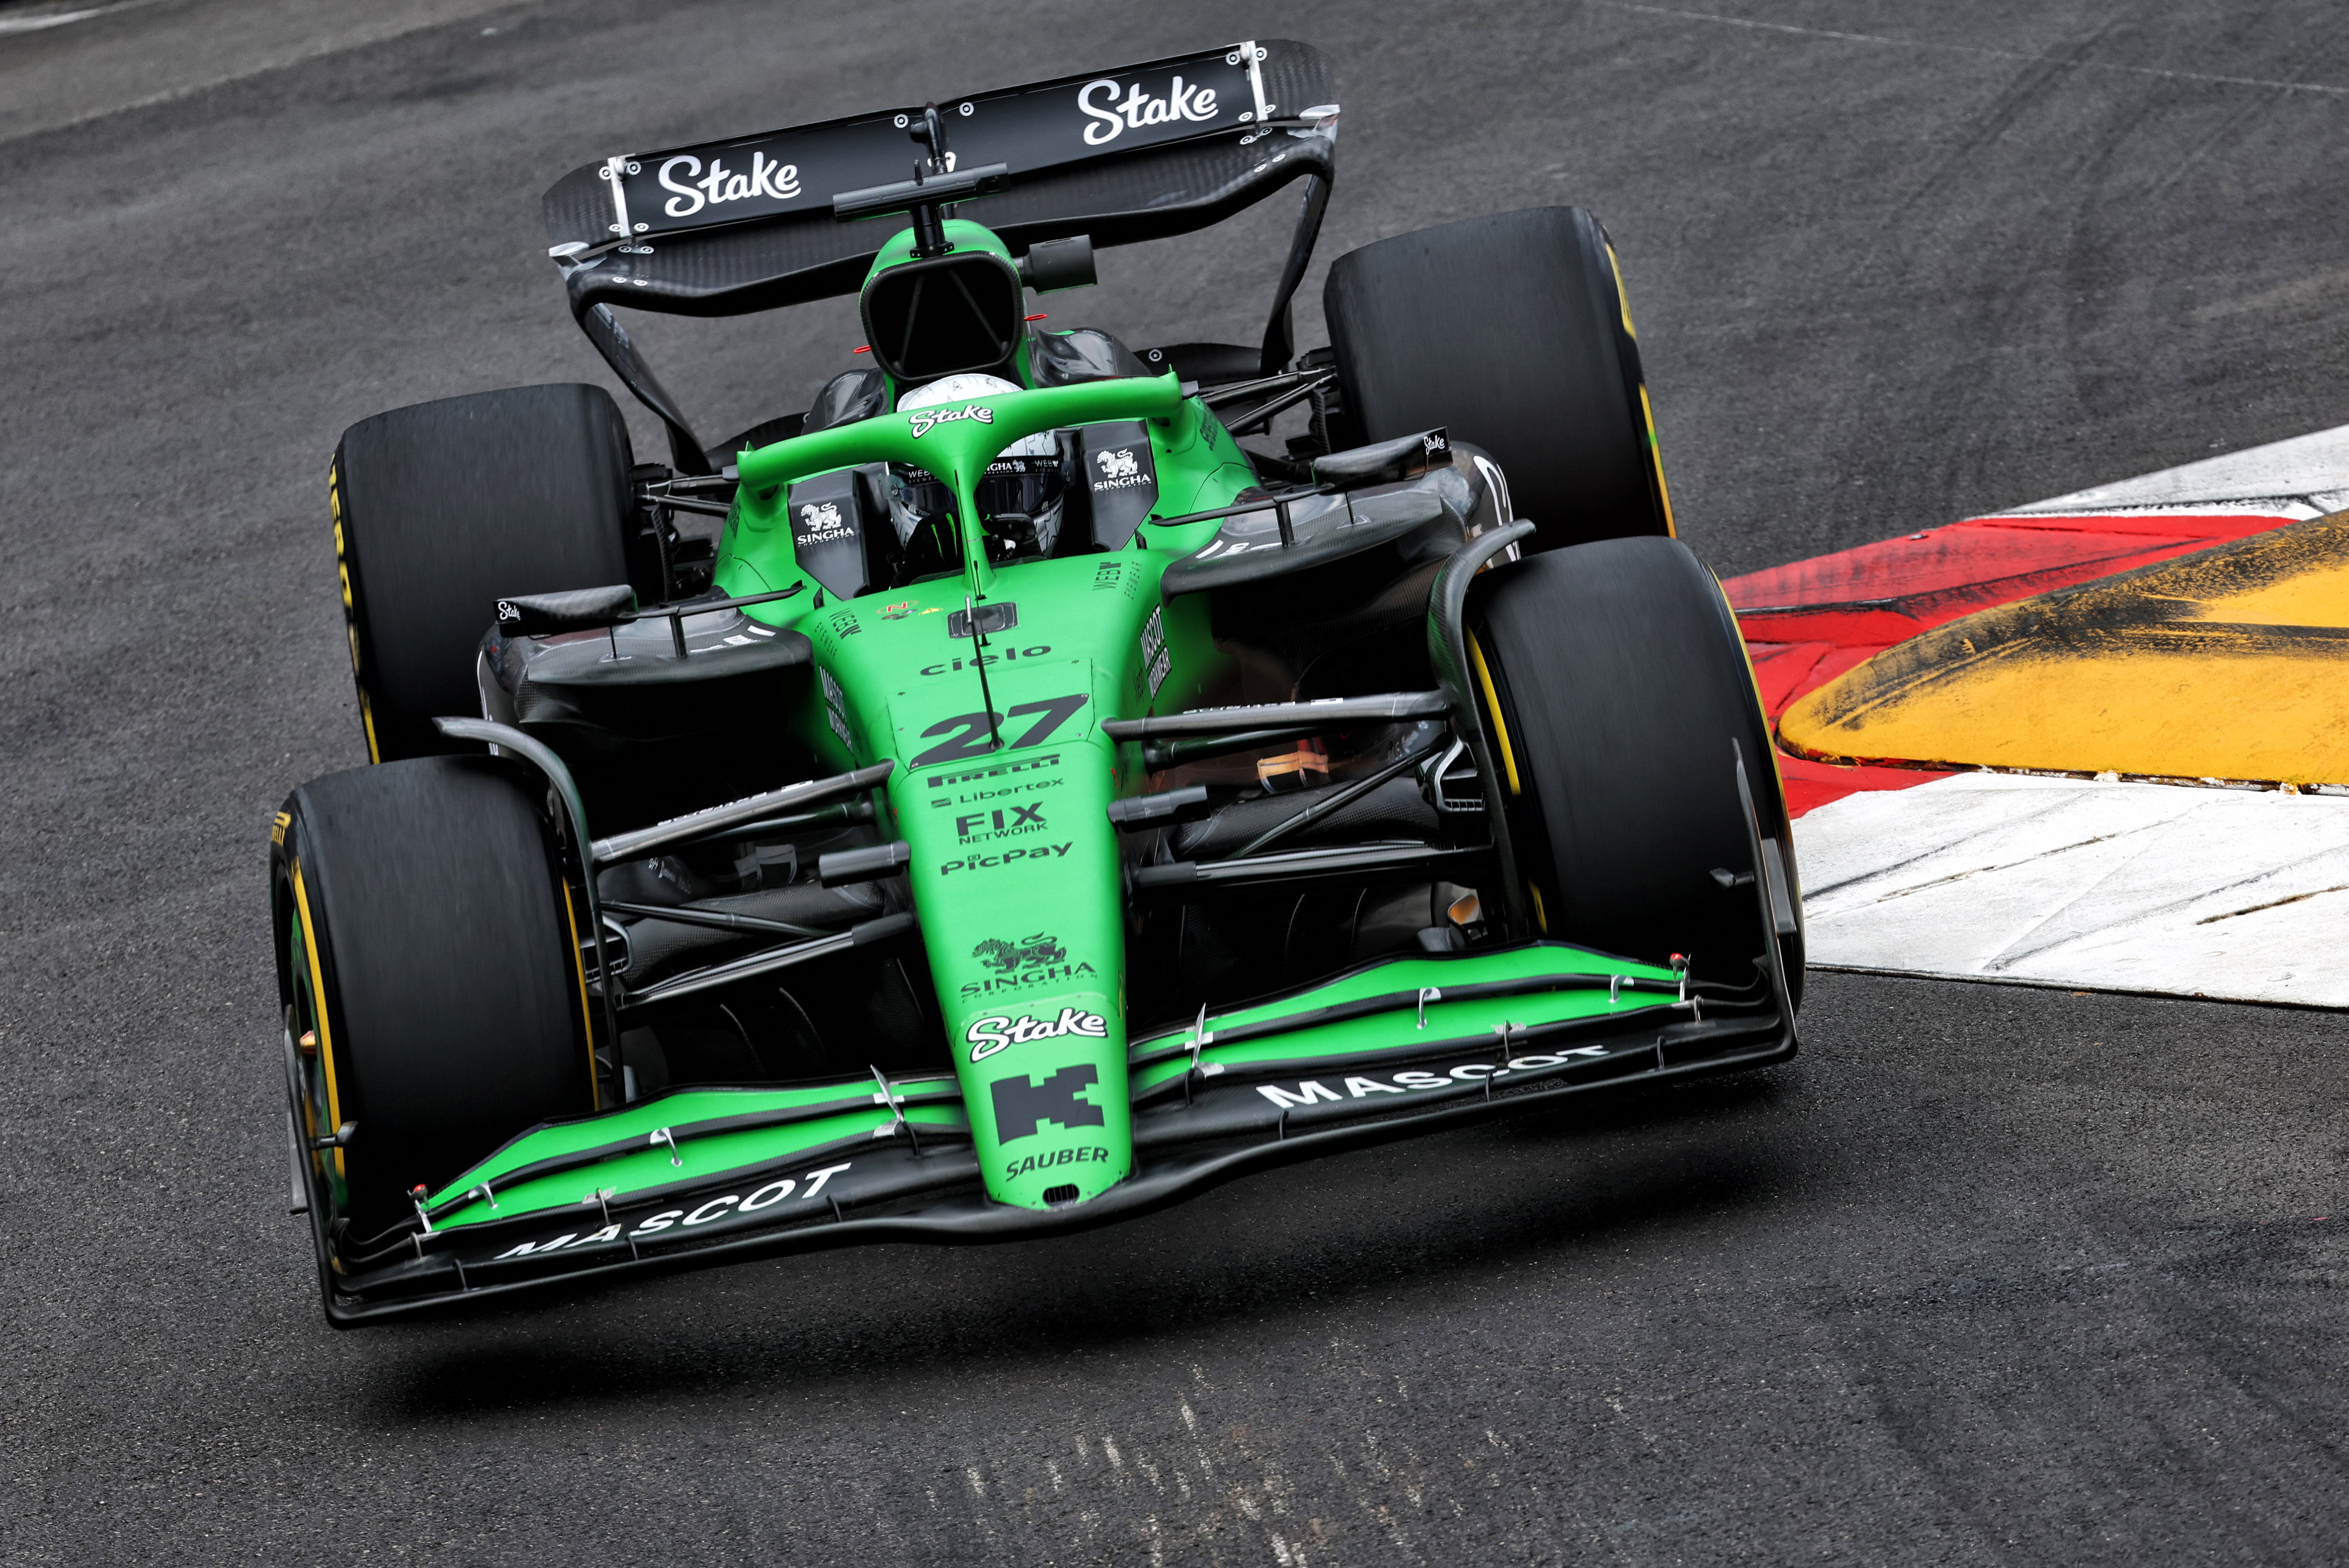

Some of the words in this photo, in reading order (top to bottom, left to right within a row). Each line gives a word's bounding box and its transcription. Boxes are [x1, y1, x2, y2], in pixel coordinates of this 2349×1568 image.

[1077, 76, 1219, 145] Stake
[658, 151, 802, 217] Stake
[909, 405, 994, 439] Stake
[1424, 435, 1445, 455] Stake
[987, 463, 1012, 471] GHA
[1094, 473, 1151, 490] SINGHA
[797, 527, 854, 545] SINGHA
[498, 601, 521, 621] Stake
[1140, 604, 1165, 671] MASCOT
[920, 645, 1052, 676] cielo
[908, 693, 1089, 770] 27
[927, 753, 1061, 789] PIRELLI
[960, 777, 1064, 804] Libertex
[956, 801, 1047, 837] FIX
[958, 821, 1048, 846] NETWORK
[941, 841, 1074, 876] PicPay
[961, 962, 1096, 999] SINGHA
[966, 1007, 1108, 1063] Stake
[1256, 1044, 1611, 1109] MASCOT
[1006, 1146, 1109, 1182] SAUBER
[493, 1162, 852, 1260] MASCOT
